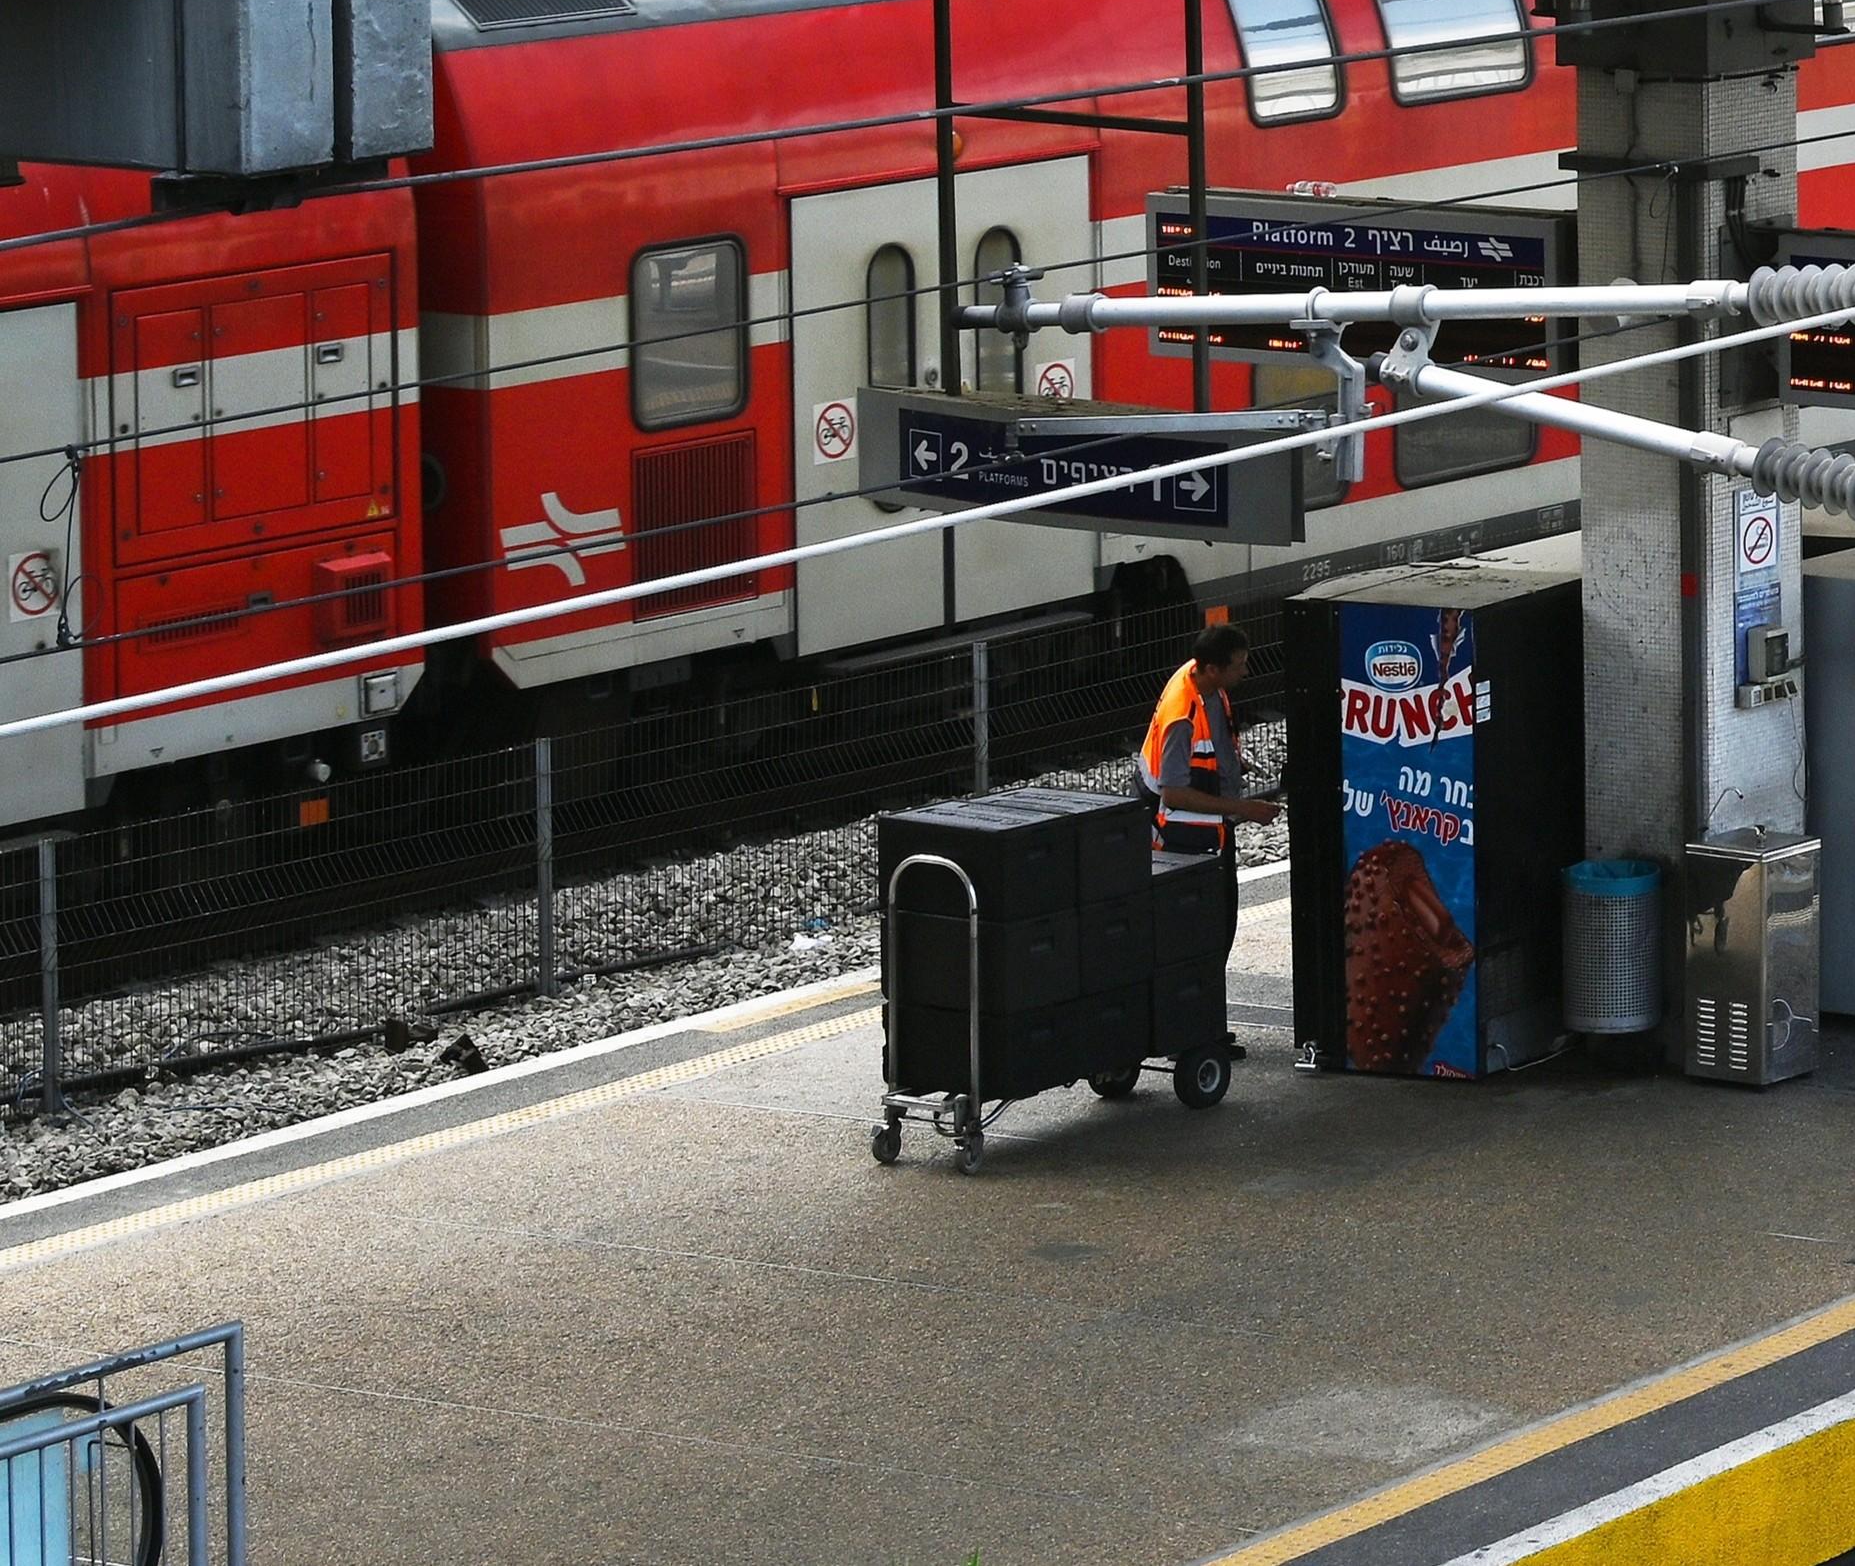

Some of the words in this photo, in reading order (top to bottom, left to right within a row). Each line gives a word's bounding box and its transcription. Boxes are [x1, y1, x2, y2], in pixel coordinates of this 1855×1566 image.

[1252, 221, 1334, 246] Platform
[1344, 227, 1356, 248] 2
[1368, 230, 1413, 255] רציף
[1423, 235, 1469, 258] رصيف
[1168, 254, 1222, 270] Destiion
[1255, 261, 1288, 275] ביניים
[1338, 262, 1375, 276] מעודכן
[1290, 265, 1324, 278] תחנות
[1389, 265, 1414, 278] שעה
[1348, 277, 1364, 289] Est
[950, 442, 969, 480] 2
[978, 470, 1029, 487] PLATFORMS
[1302, 560, 1331, 581] 2295
[1378, 644, 1408, 653] גלידות
[1398, 766, 1432, 797] מה
